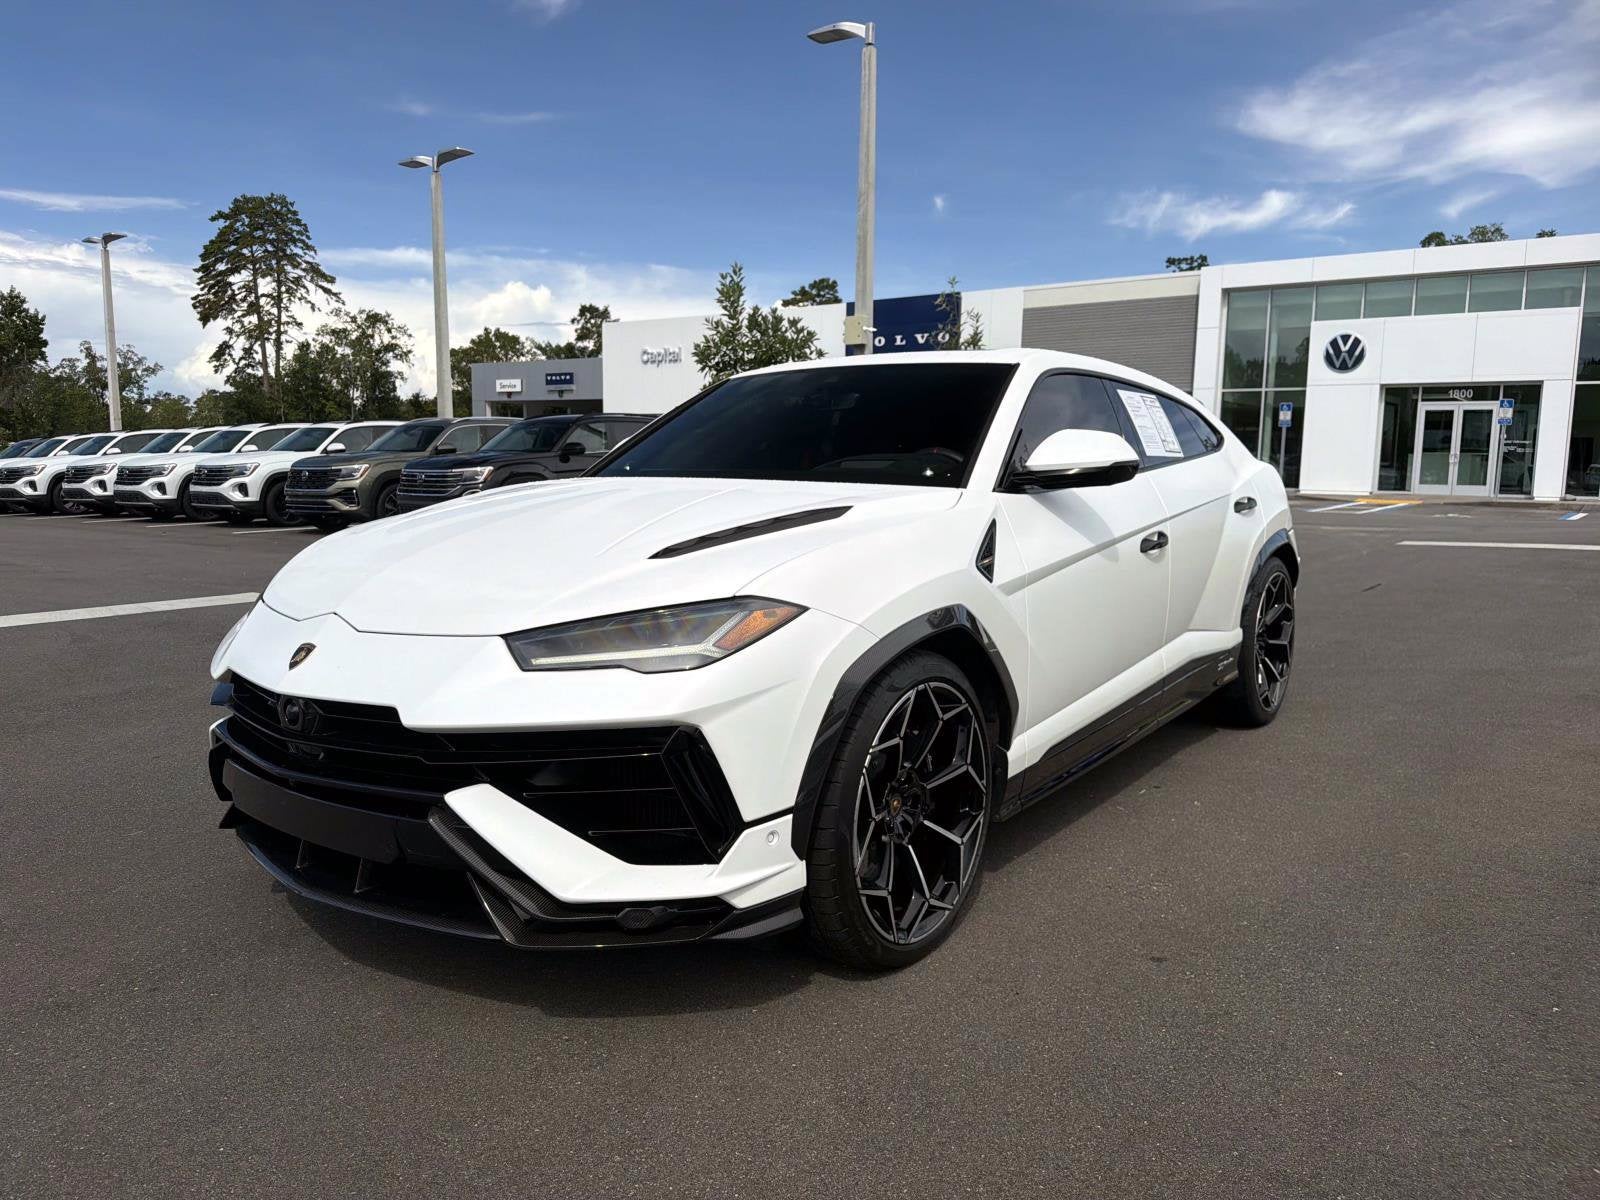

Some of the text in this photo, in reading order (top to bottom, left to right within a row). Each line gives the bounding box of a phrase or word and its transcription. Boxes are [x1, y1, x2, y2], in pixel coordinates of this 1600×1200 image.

[874, 332, 949, 347] OLVO
[640, 347, 682, 367] Capital
[499, 382, 517, 390] Service
[1448, 388, 1474, 399] 1800
